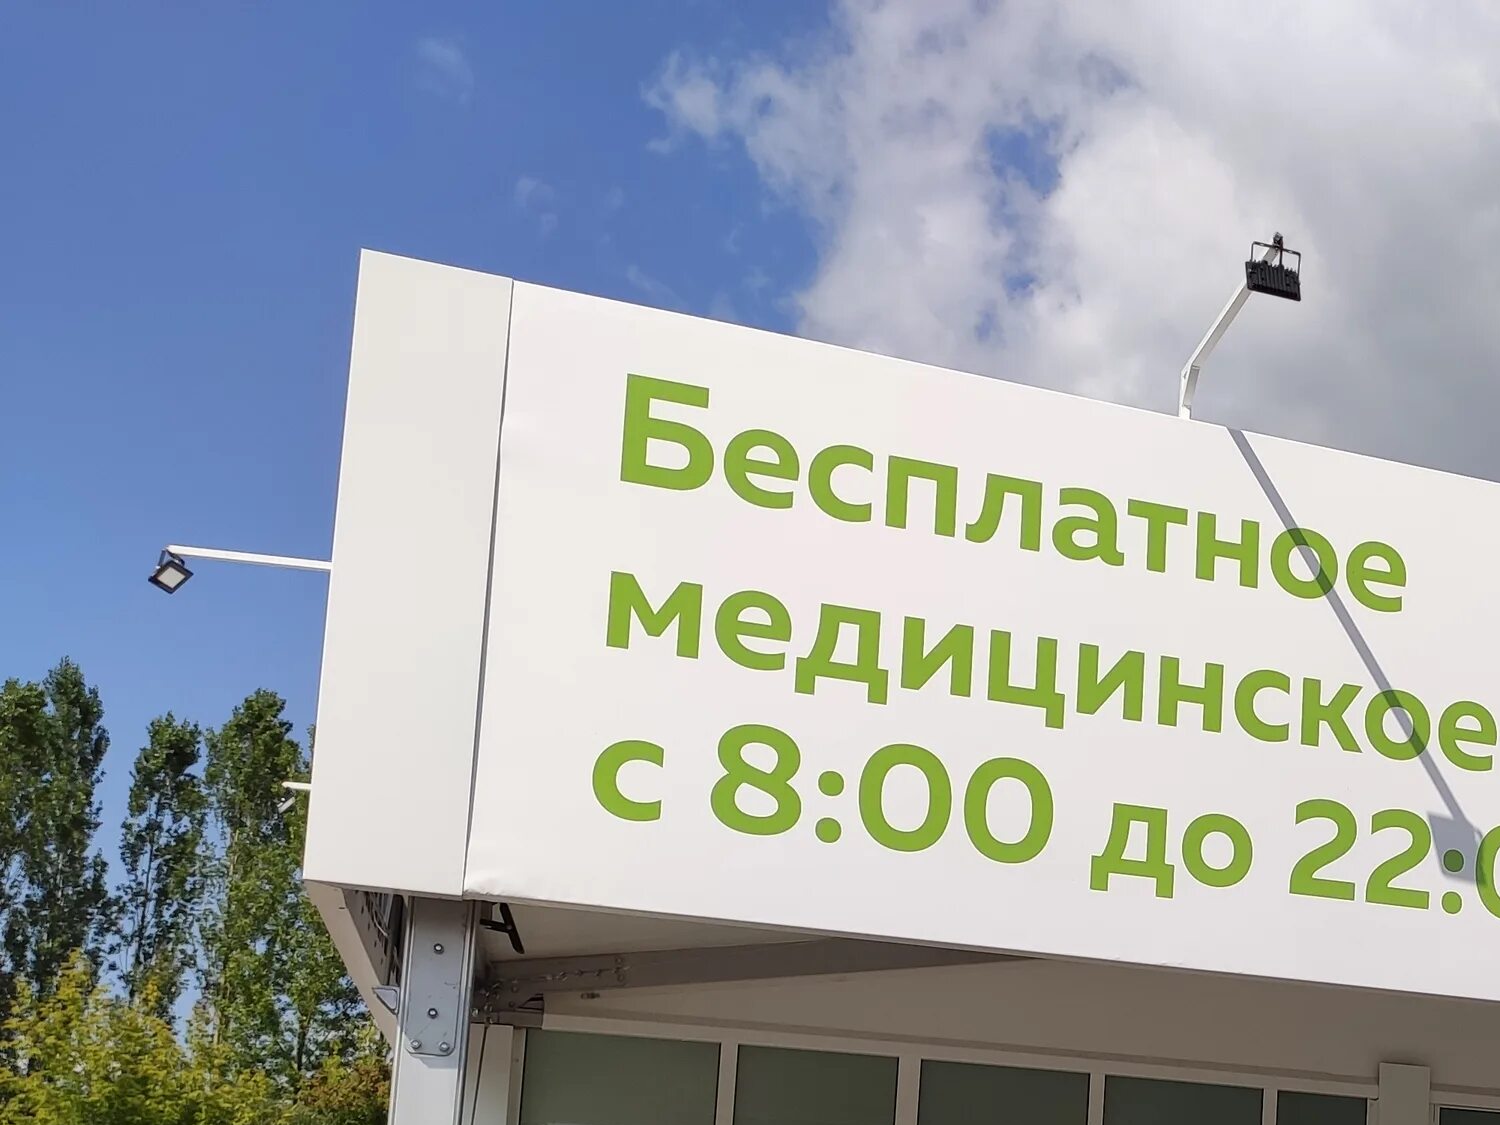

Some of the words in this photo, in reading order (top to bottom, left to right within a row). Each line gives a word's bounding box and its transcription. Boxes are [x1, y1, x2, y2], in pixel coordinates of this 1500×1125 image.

[620, 373, 1408, 613] Бесплатное
[605, 570, 1499, 773] медицинское
[591, 739, 665, 823] с
[710, 723, 1055, 865] 8:00
[1089, 802, 1254, 900] до
